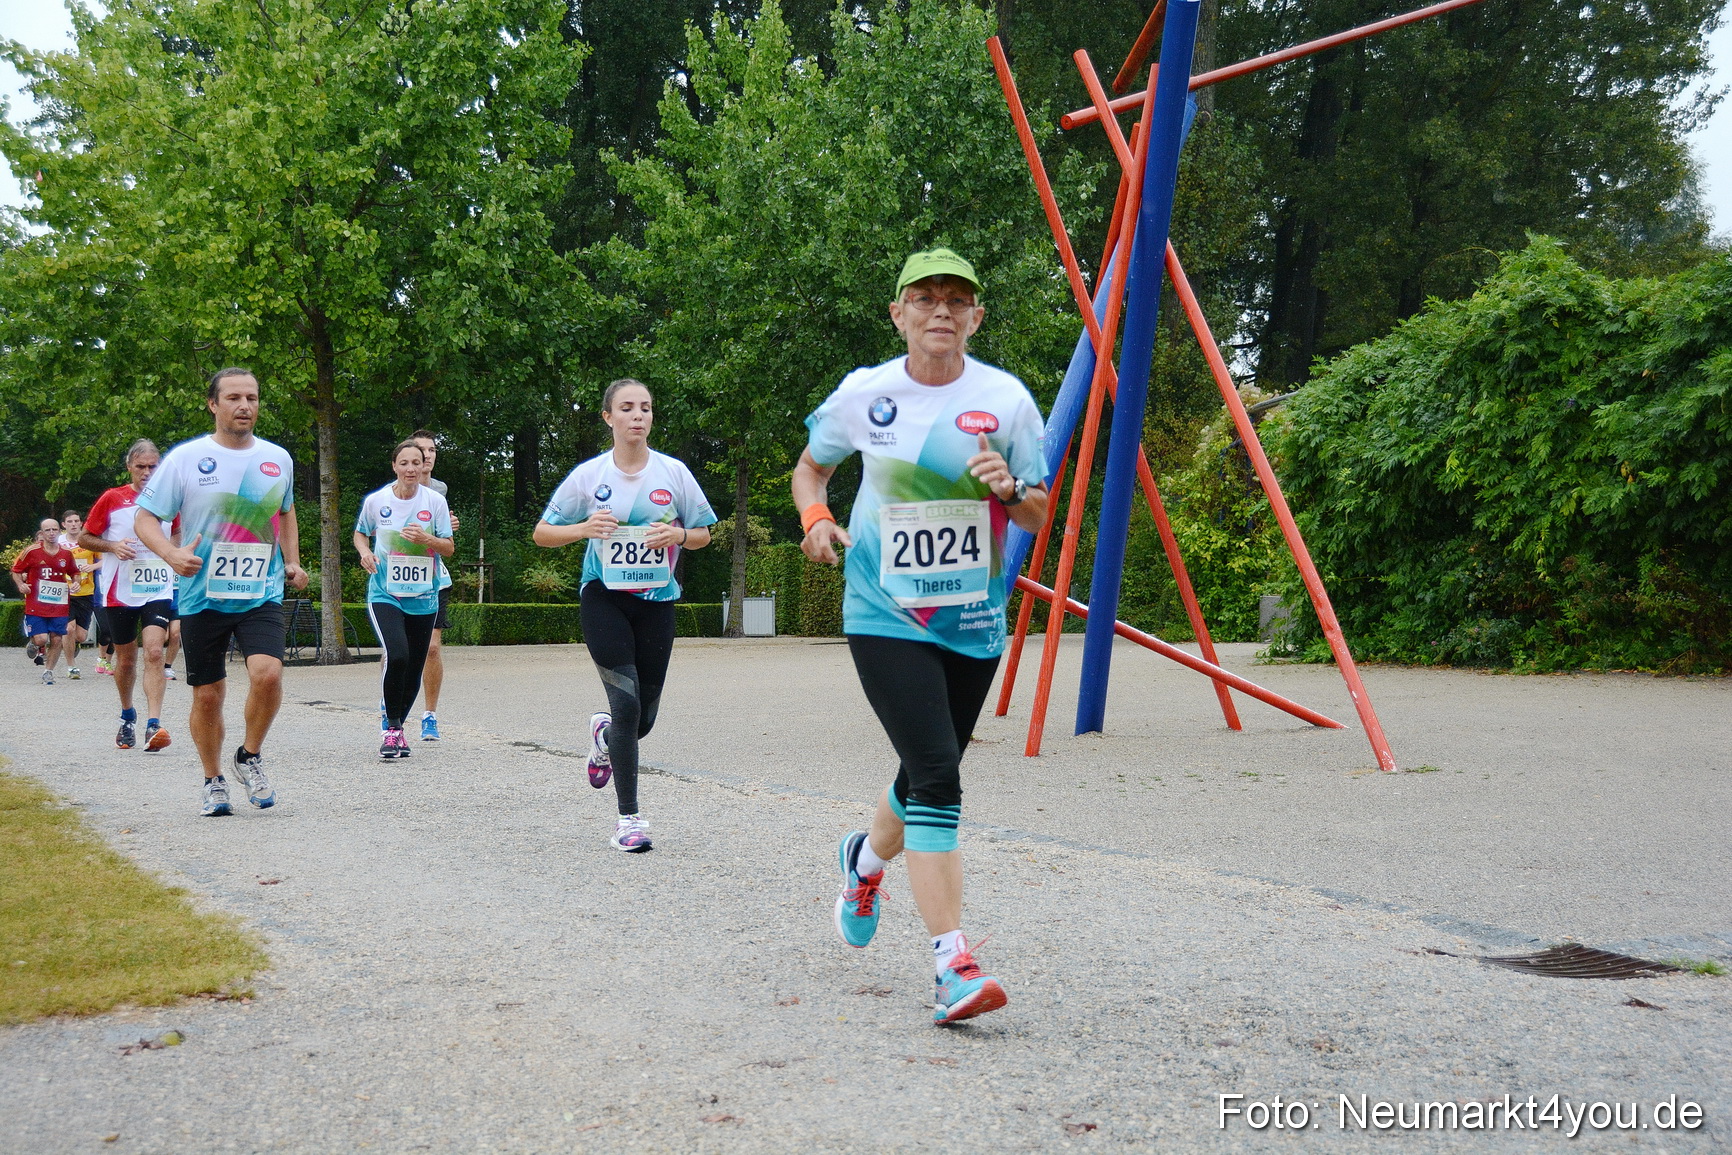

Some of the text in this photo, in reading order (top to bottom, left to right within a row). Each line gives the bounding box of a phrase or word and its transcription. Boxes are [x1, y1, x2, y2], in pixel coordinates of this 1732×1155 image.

[869, 432, 897, 440] PARTL
[926, 504, 979, 518] BOCK
[610, 542, 664, 565] 2829
[893, 526, 980, 567] 2024
[215, 556, 266, 577] 2127
[392, 566, 427, 581] 3061
[134, 568, 168, 583] 2049
[621, 571, 654, 582] Tatjana
[40, 585, 63, 596] 2798
[227, 582, 251, 592] Siega
[914, 579, 961, 593] Theres
